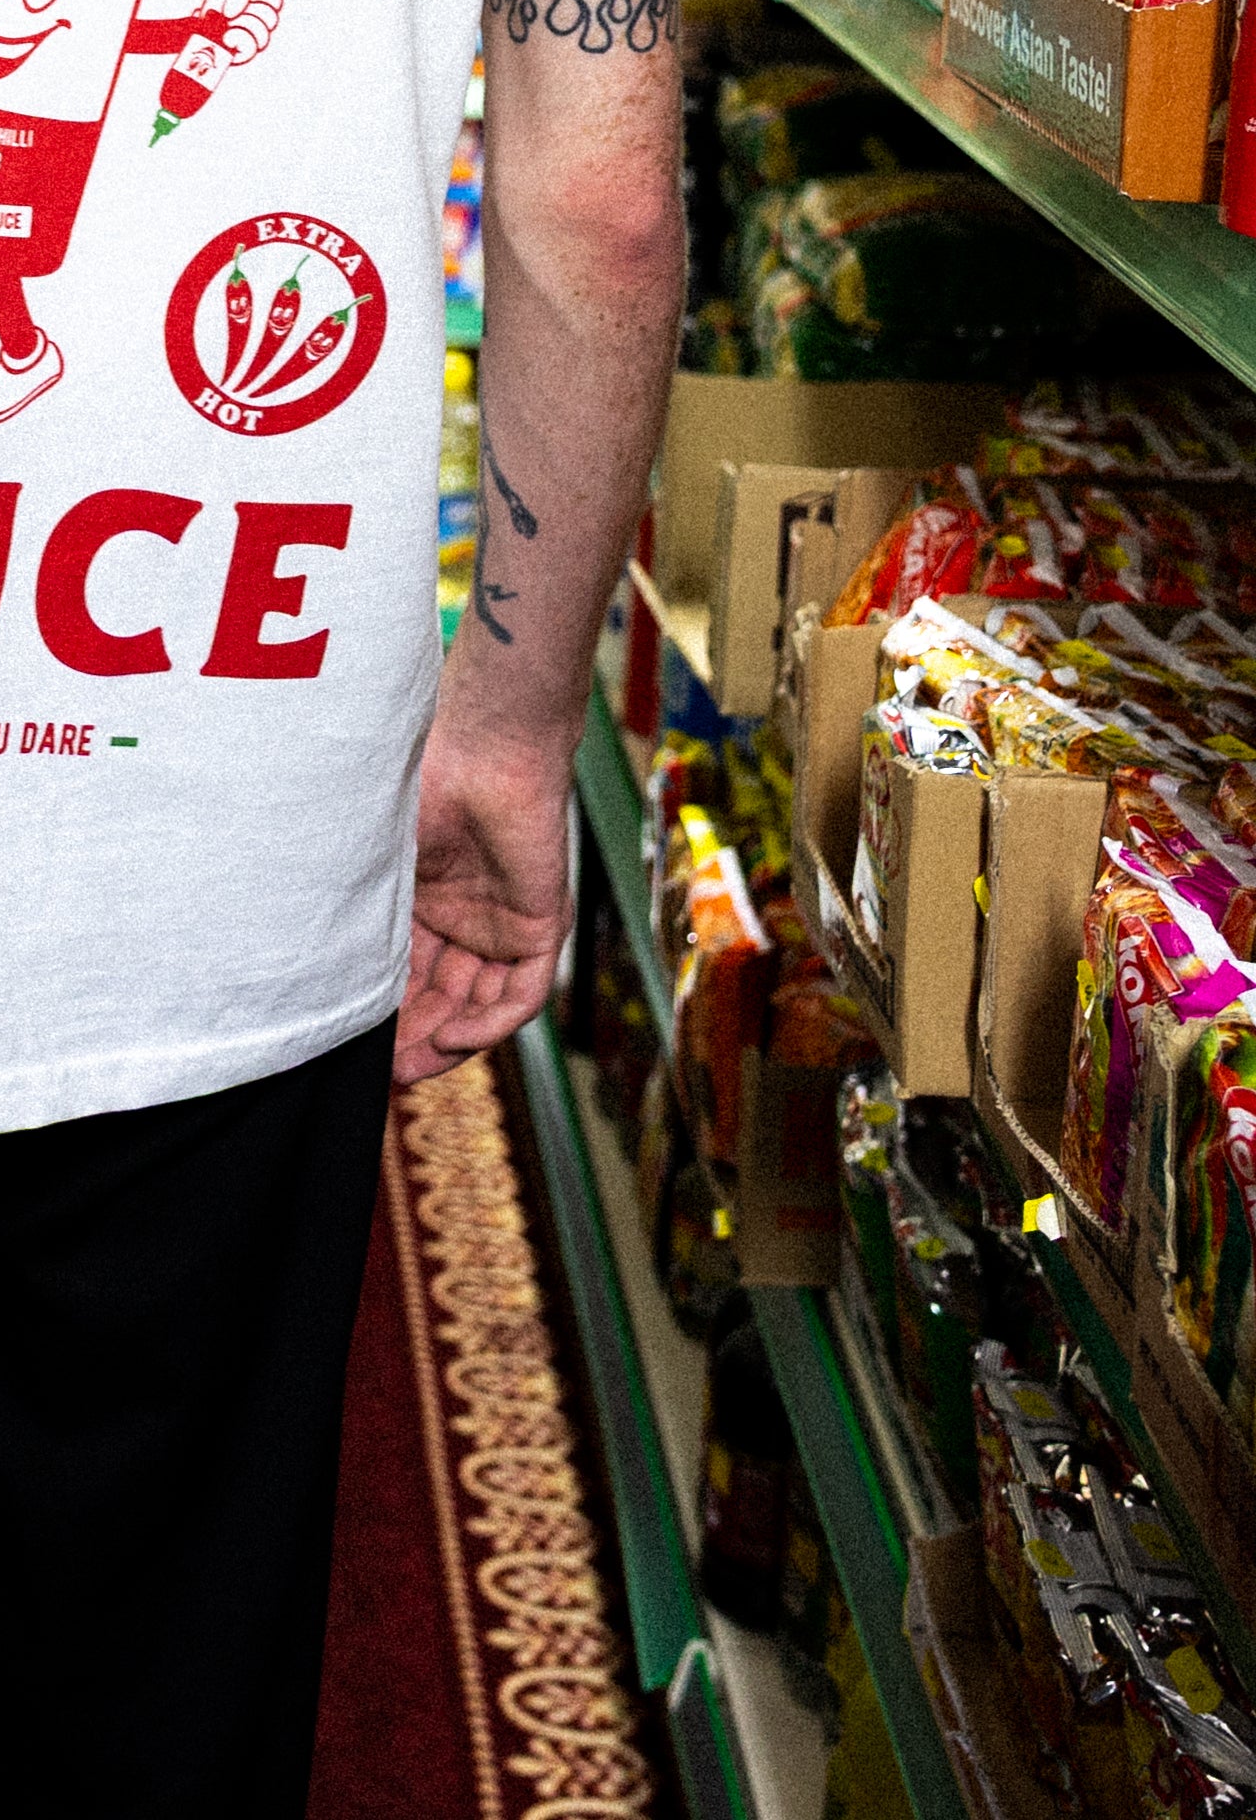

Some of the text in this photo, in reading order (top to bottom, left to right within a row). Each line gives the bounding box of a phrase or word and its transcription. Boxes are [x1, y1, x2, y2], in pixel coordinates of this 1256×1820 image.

[1008, 9, 1054, 82] Asian
[1057, 35, 1112, 118] Taste!
[255, 217, 363, 277] EXTRA
[193, 387, 264, 432] HOT
[20, 721, 96, 757] DARE
